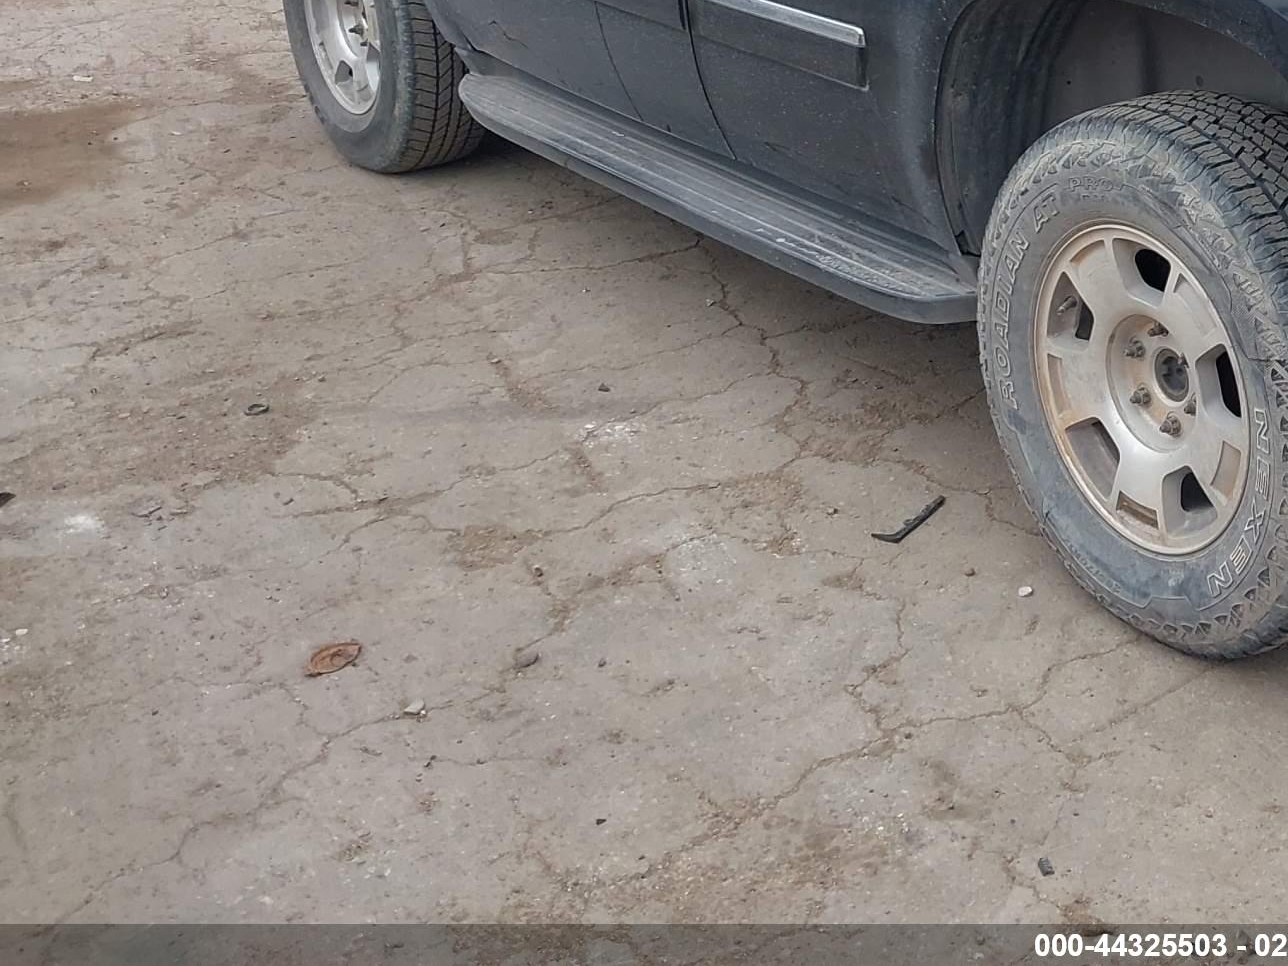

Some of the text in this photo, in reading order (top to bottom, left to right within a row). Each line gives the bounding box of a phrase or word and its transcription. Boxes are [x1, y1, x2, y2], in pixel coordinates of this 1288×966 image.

[992, 231, 1031, 410] ROADIAN
[1032, 193, 1061, 233] AT
[1068, 176, 1114, 192] PRO
[1206, 407, 1271, 598] NEXEN
